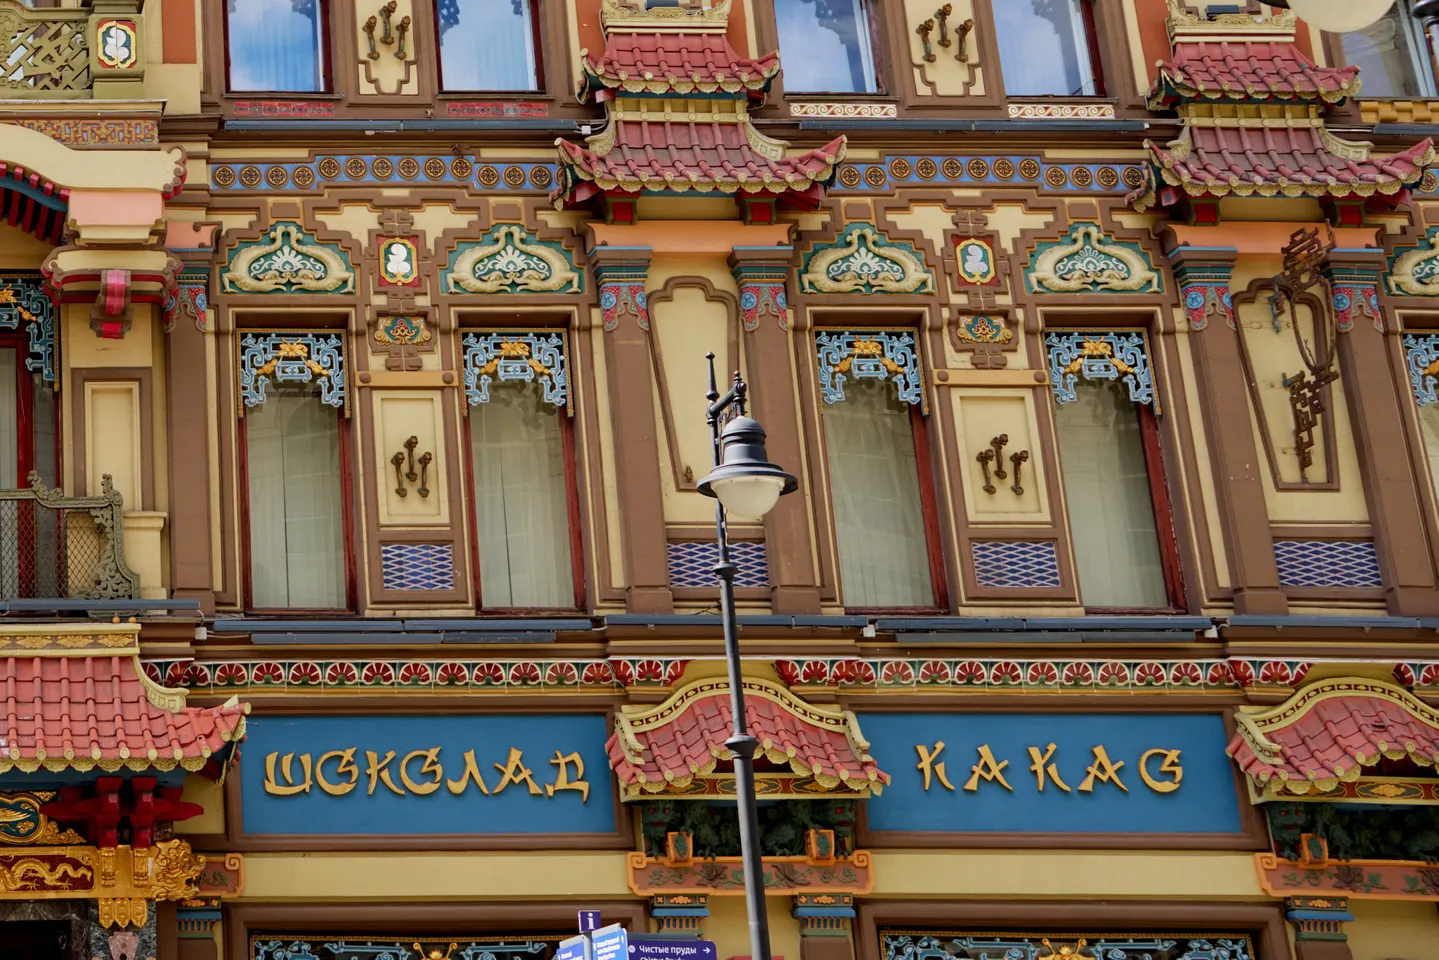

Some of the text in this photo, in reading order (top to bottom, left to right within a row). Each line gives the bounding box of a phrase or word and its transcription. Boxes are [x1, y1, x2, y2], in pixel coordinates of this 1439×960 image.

[264, 747, 590, 803] ШОКОЛАД
[915, 741, 1184, 793] КАКАО
[587, 913, 596, 929] i
[639, 945, 697, 955] Чистые пруды
